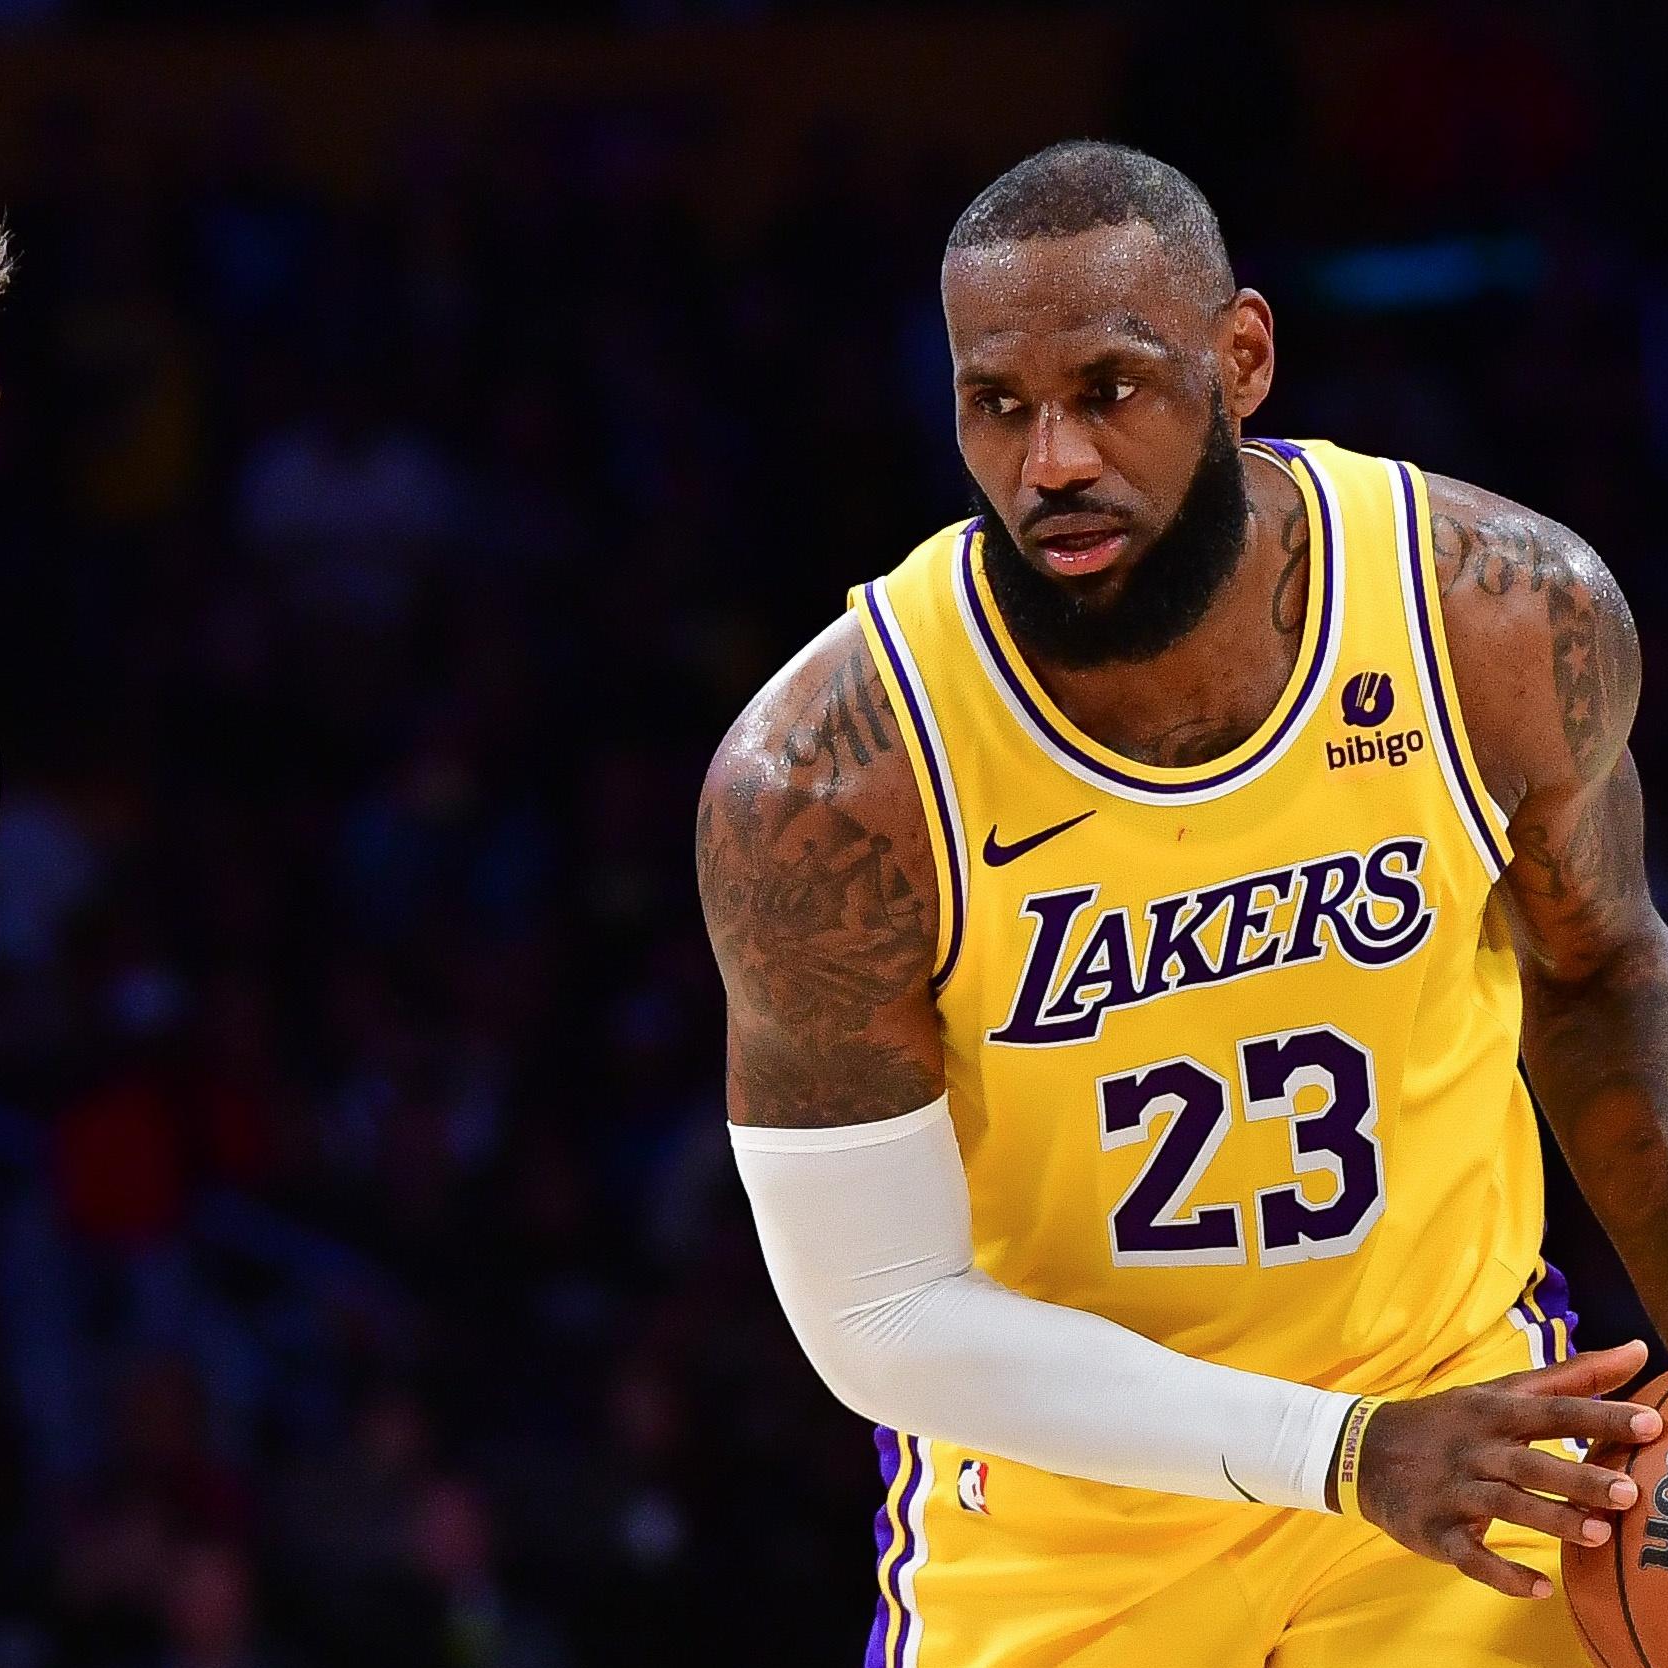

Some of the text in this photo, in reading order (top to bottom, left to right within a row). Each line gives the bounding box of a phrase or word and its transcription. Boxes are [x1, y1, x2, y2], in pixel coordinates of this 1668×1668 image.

[1325, 729, 1424, 771] bibigo
[984, 835, 1438, 1049] LAKERS
[1095, 1022, 1387, 1269] 23
[1341, 1406, 1369, 1483] PROMISE
